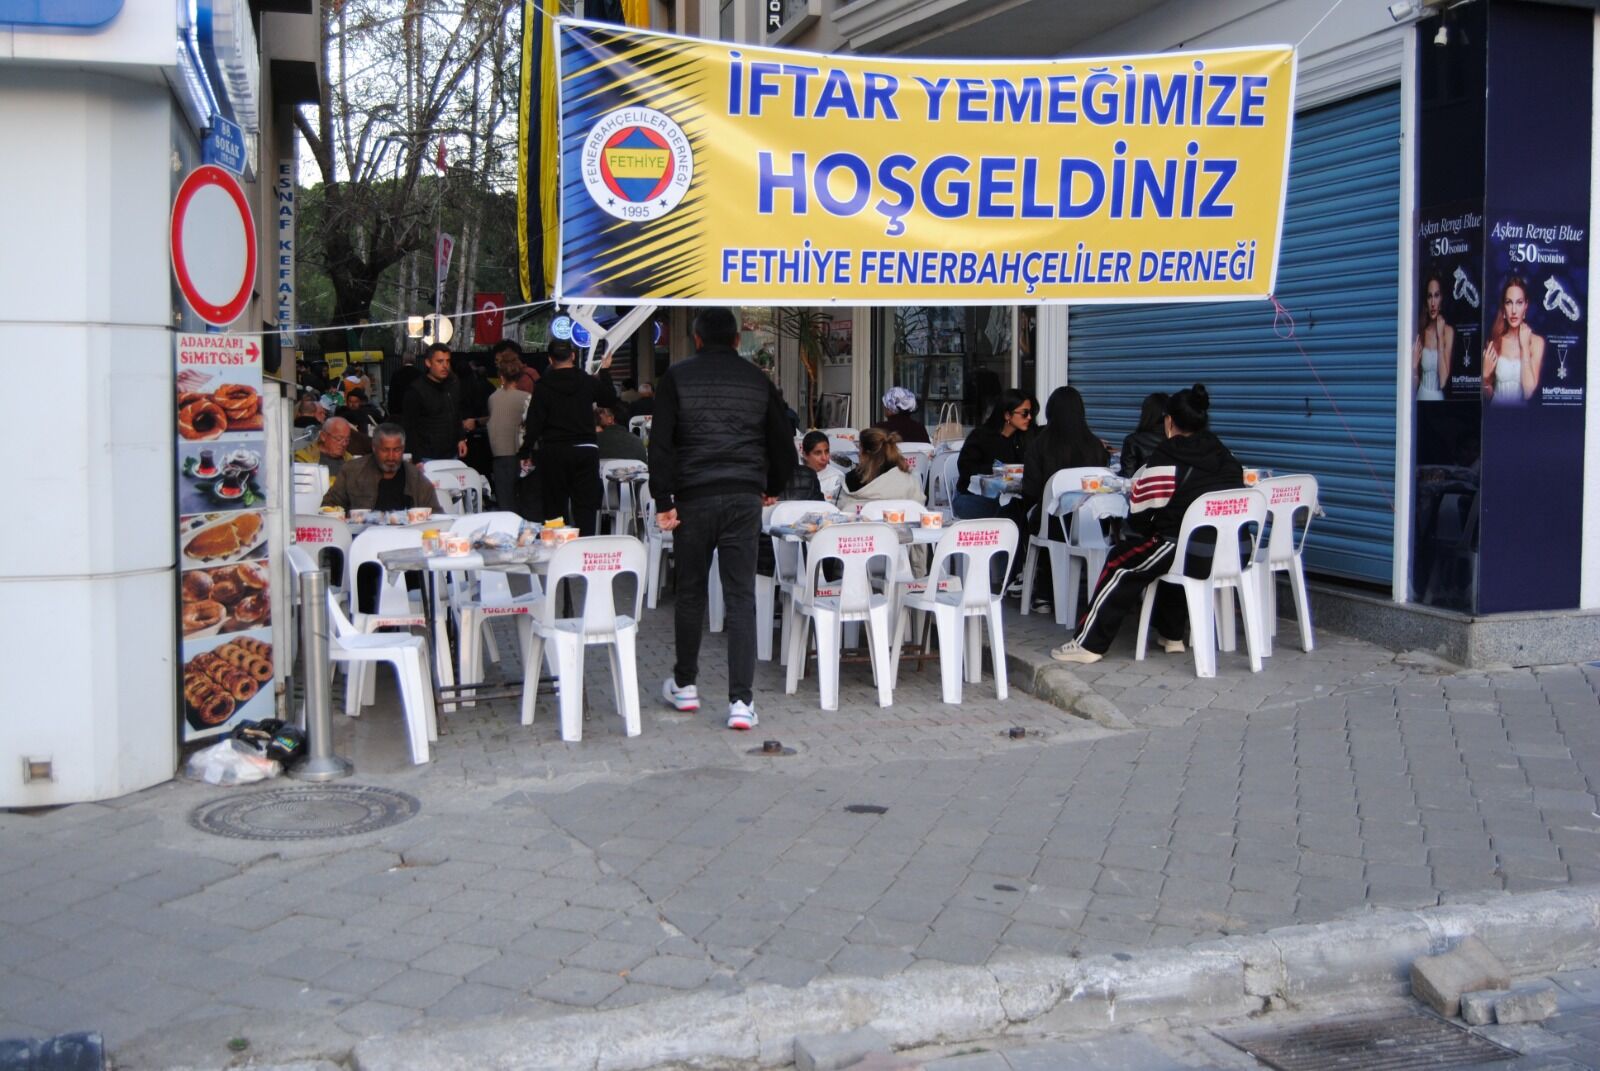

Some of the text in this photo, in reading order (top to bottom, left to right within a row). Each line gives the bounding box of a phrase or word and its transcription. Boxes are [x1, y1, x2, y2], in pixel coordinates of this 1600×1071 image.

[728, 50, 1270, 127] İFTAR YEMEĞİMİZE
[215, 135, 240, 159] SOKAK
[609, 154, 665, 169] FETHİYE
[279, 164, 293, 230] ESNAF
[757, 139, 1239, 238] HOŞGELDİNİZ
[621, 206, 650, 218] 1995
[1463, 212, 1482, 229] Blue
[1491, 221, 1583, 244] Aşkın Rengi Blue
[721, 239, 1257, 294] FETHİYE FENERBAHÇELİLER DERNEĞİ
[180, 336, 244, 349] ADAPAZARI
